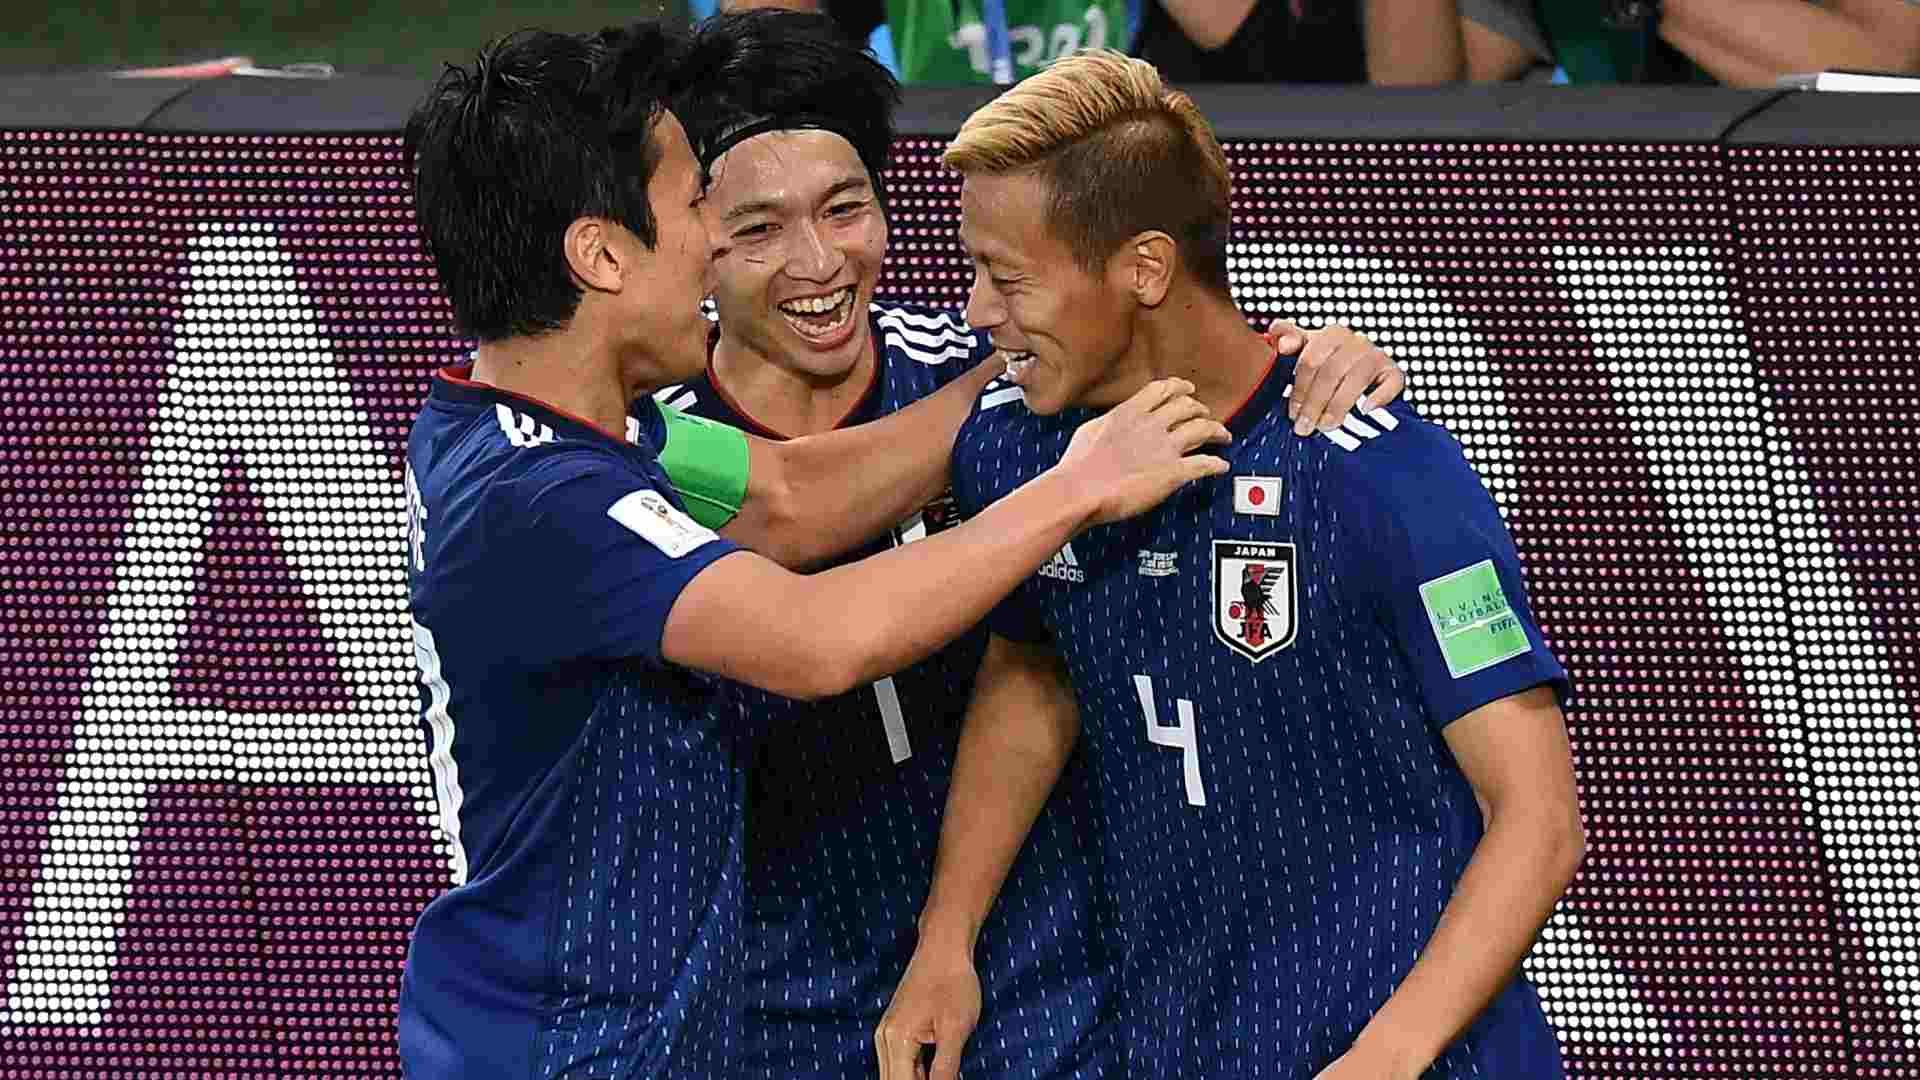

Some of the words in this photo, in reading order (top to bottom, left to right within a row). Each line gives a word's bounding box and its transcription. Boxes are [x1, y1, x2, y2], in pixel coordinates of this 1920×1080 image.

[1234, 546, 1276, 558] JAPAN
[1237, 622, 1272, 640] JFA
[1489, 618, 1517, 635] FIFA
[1133, 674, 1206, 806] 4
